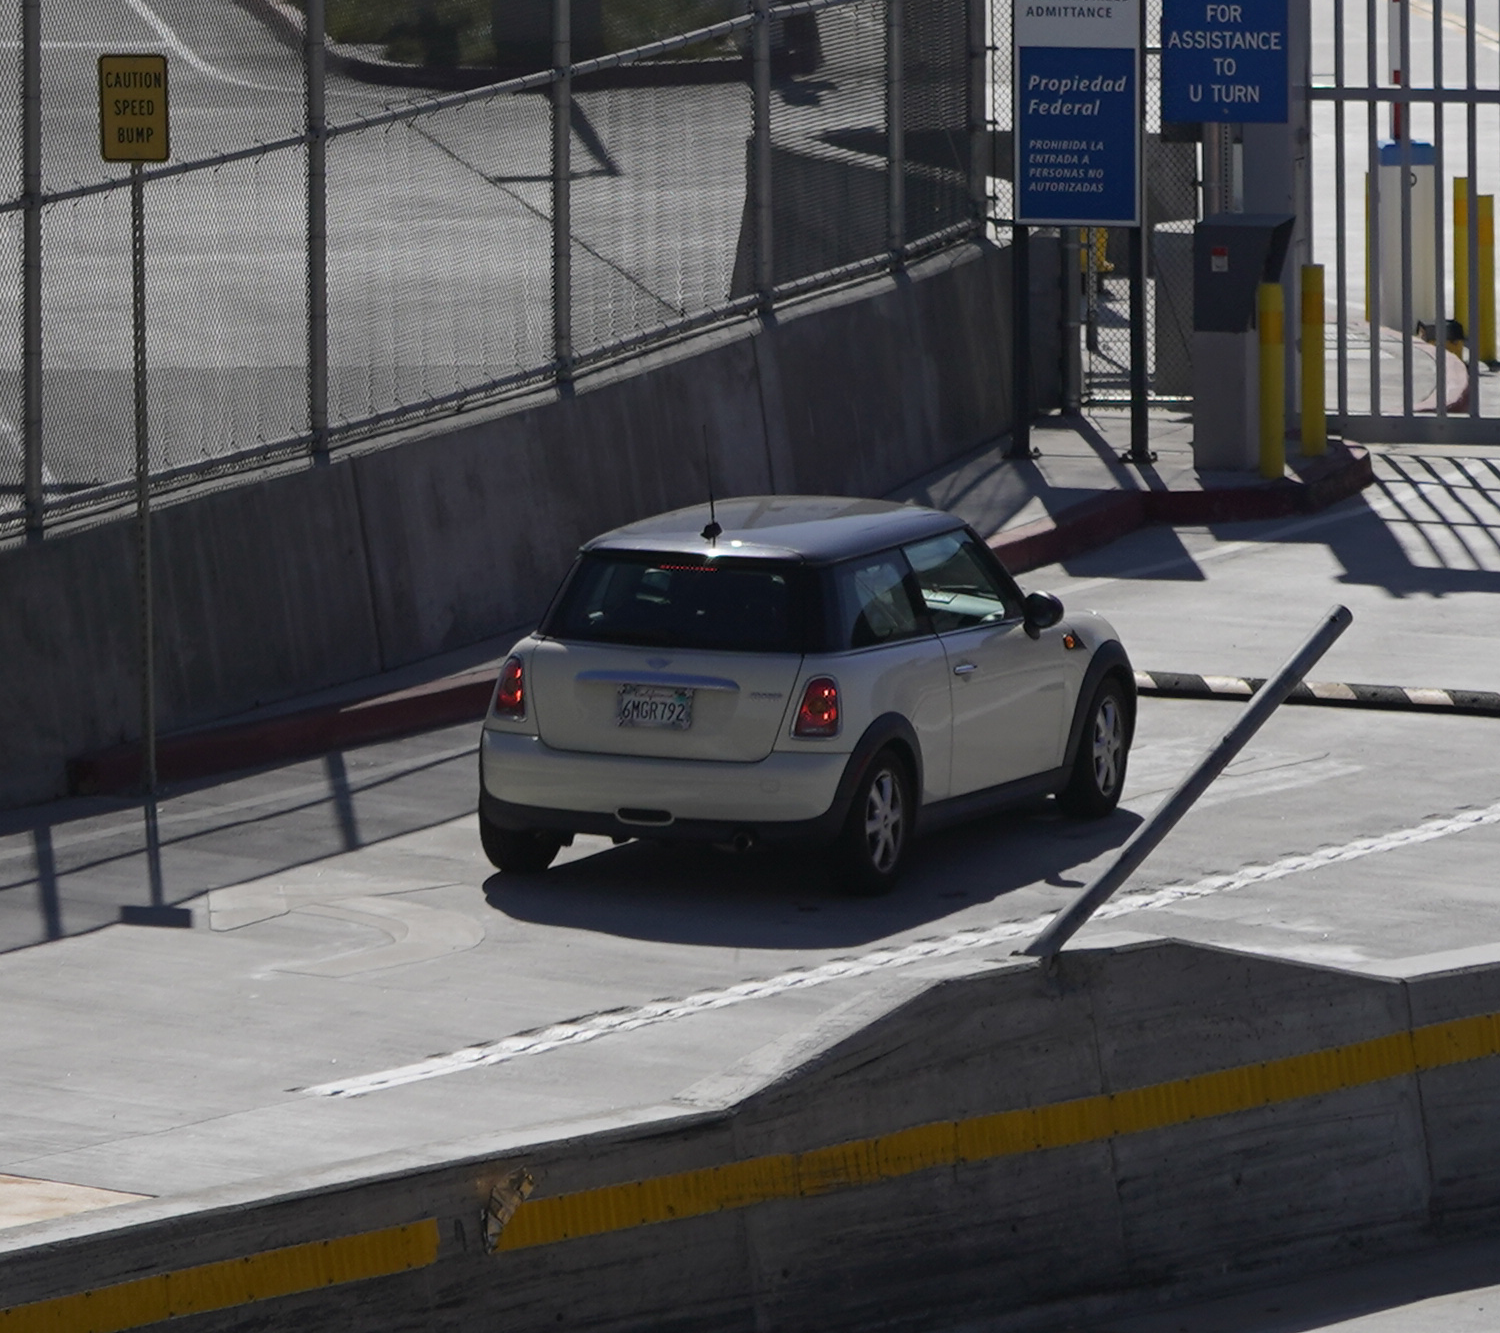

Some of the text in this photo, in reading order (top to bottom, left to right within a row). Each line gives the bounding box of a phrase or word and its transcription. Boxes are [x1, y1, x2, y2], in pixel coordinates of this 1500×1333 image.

[1026, 6, 1113, 18] ADMITTANCE
[1206, 4, 1242, 23] FOR
[1168, 31, 1282, 50] ASSISTANCE
[1213, 58, 1237, 76] TO
[105, 72, 161, 89] CAUTION
[1028, 75, 1127, 95] Propiedad
[1189, 84, 1260, 103] U TURN
[114, 99, 154, 116] SPEED
[1028, 99, 1101, 116] Federal
[1029, 140, 1104, 151] PROHIBIDA LA
[1029, 154, 1090, 164] ENTRADA A
[1029, 168, 1104, 178] PERSONAS NO
[1028, 182, 1104, 193] AUTORIZADAS
[622, 699, 685, 722] 6MGR792
